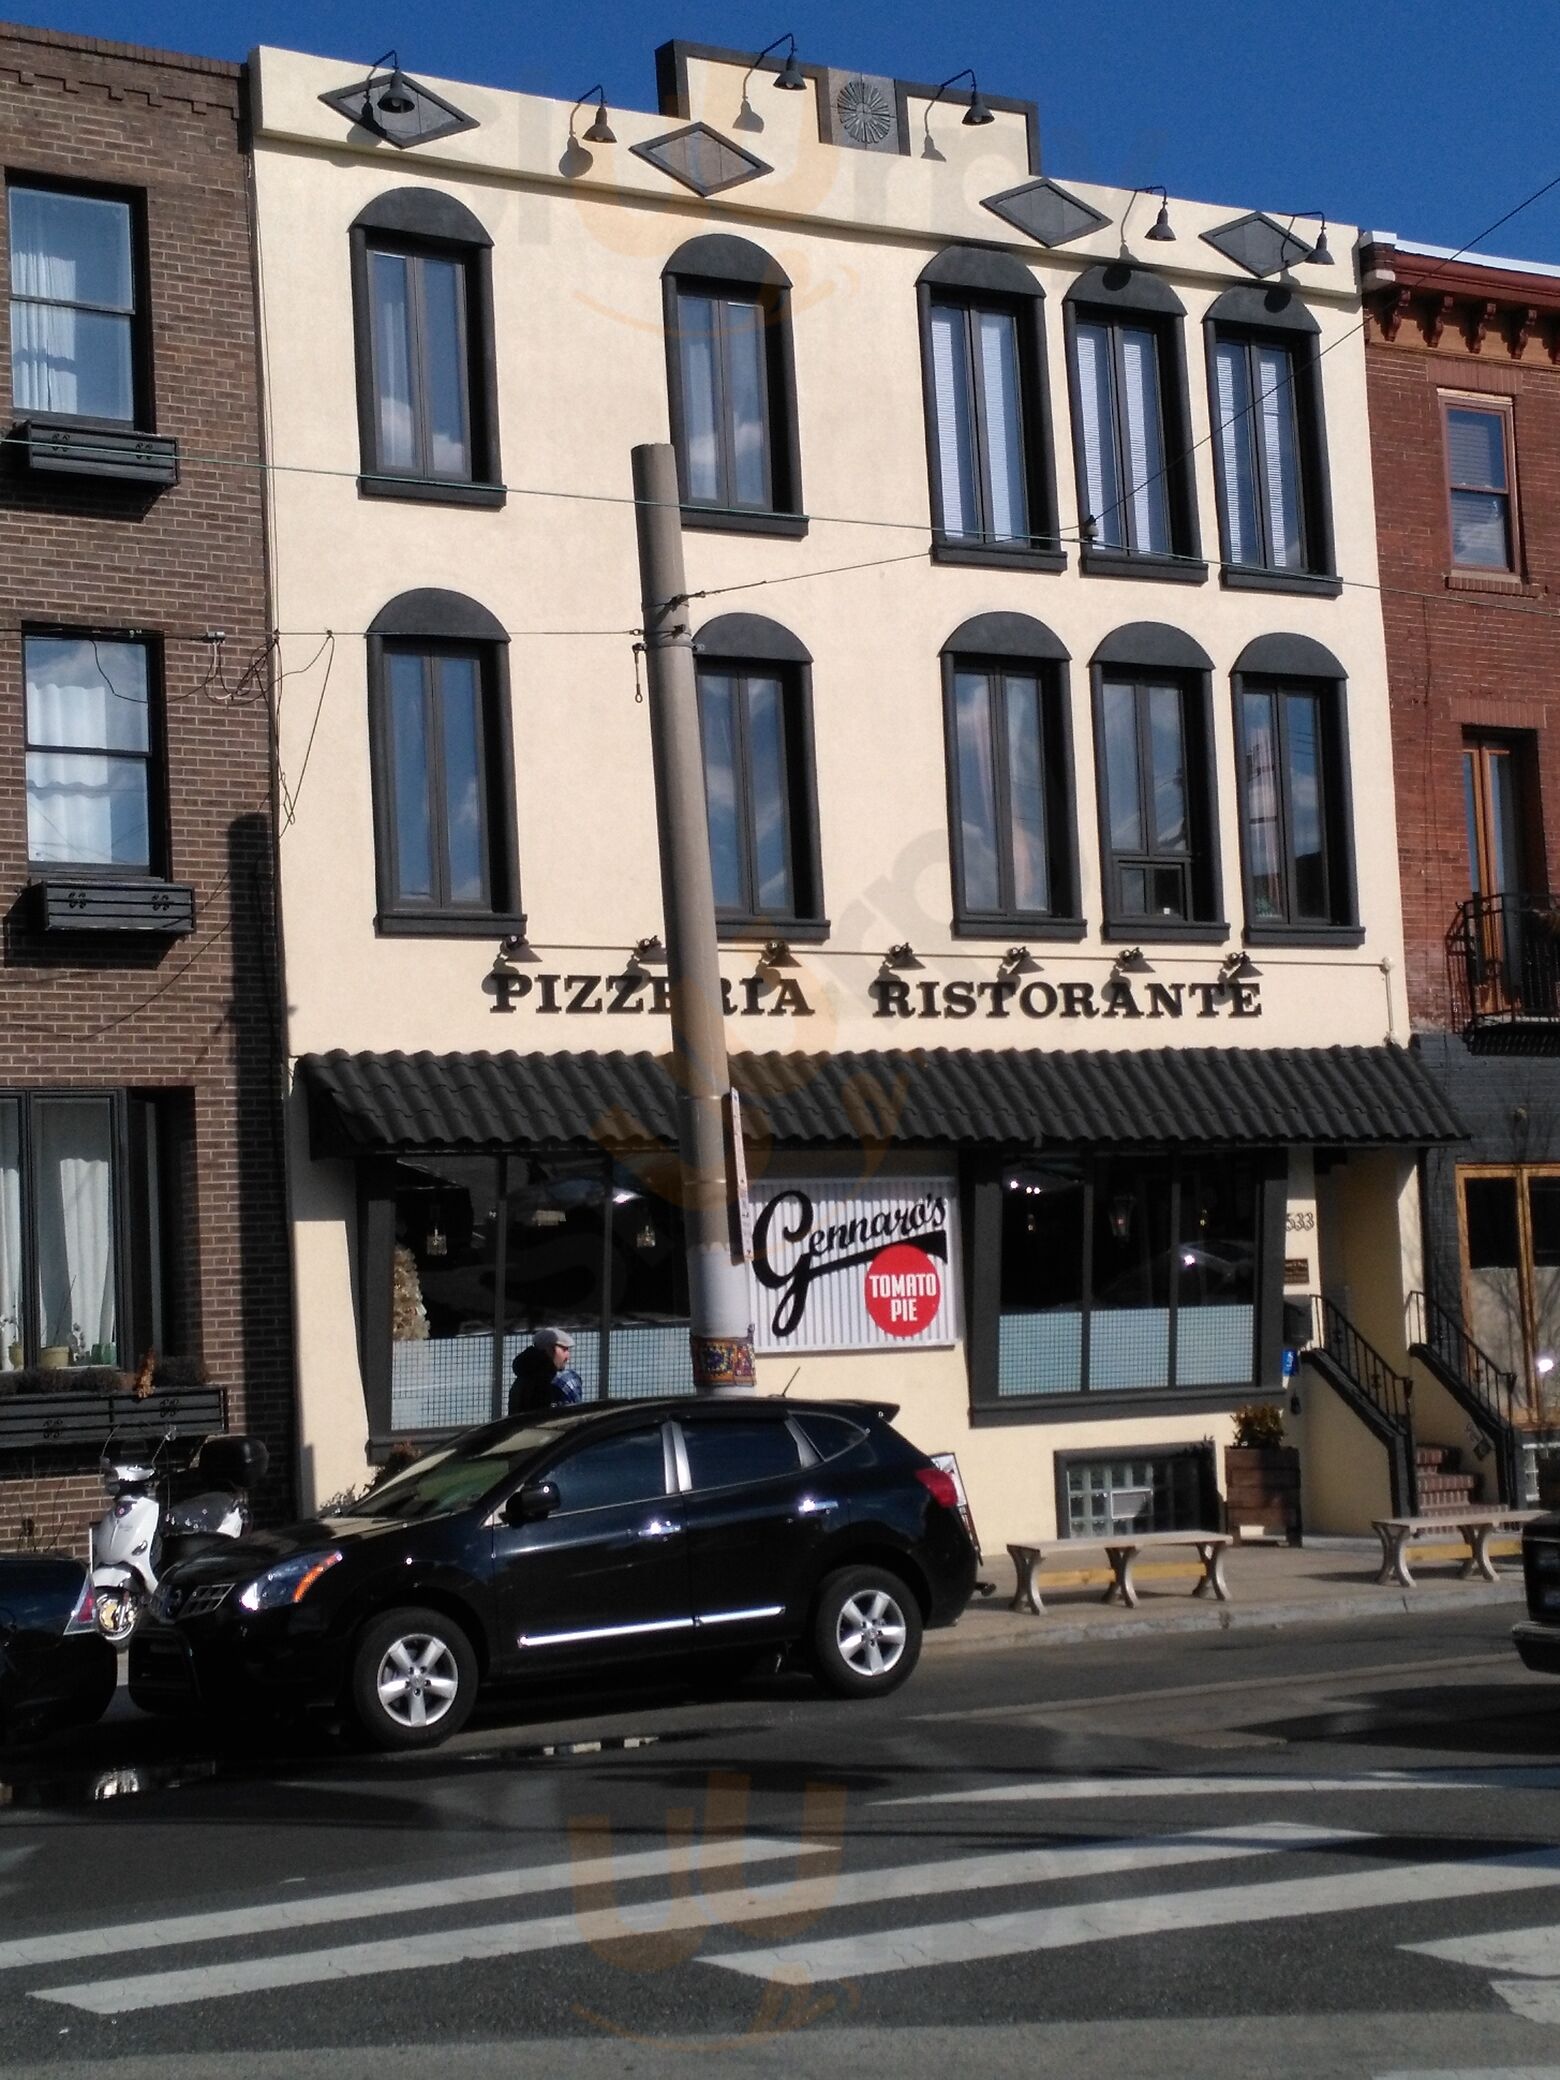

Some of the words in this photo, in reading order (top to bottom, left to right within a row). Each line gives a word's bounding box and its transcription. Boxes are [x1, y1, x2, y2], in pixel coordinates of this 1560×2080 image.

[873, 981, 1263, 1018] RISTORANTE
[751, 1190, 947, 1338] Gennaro's
[868, 1273, 938, 1298] TOMATO
[891, 1298, 919, 1322] PIE
